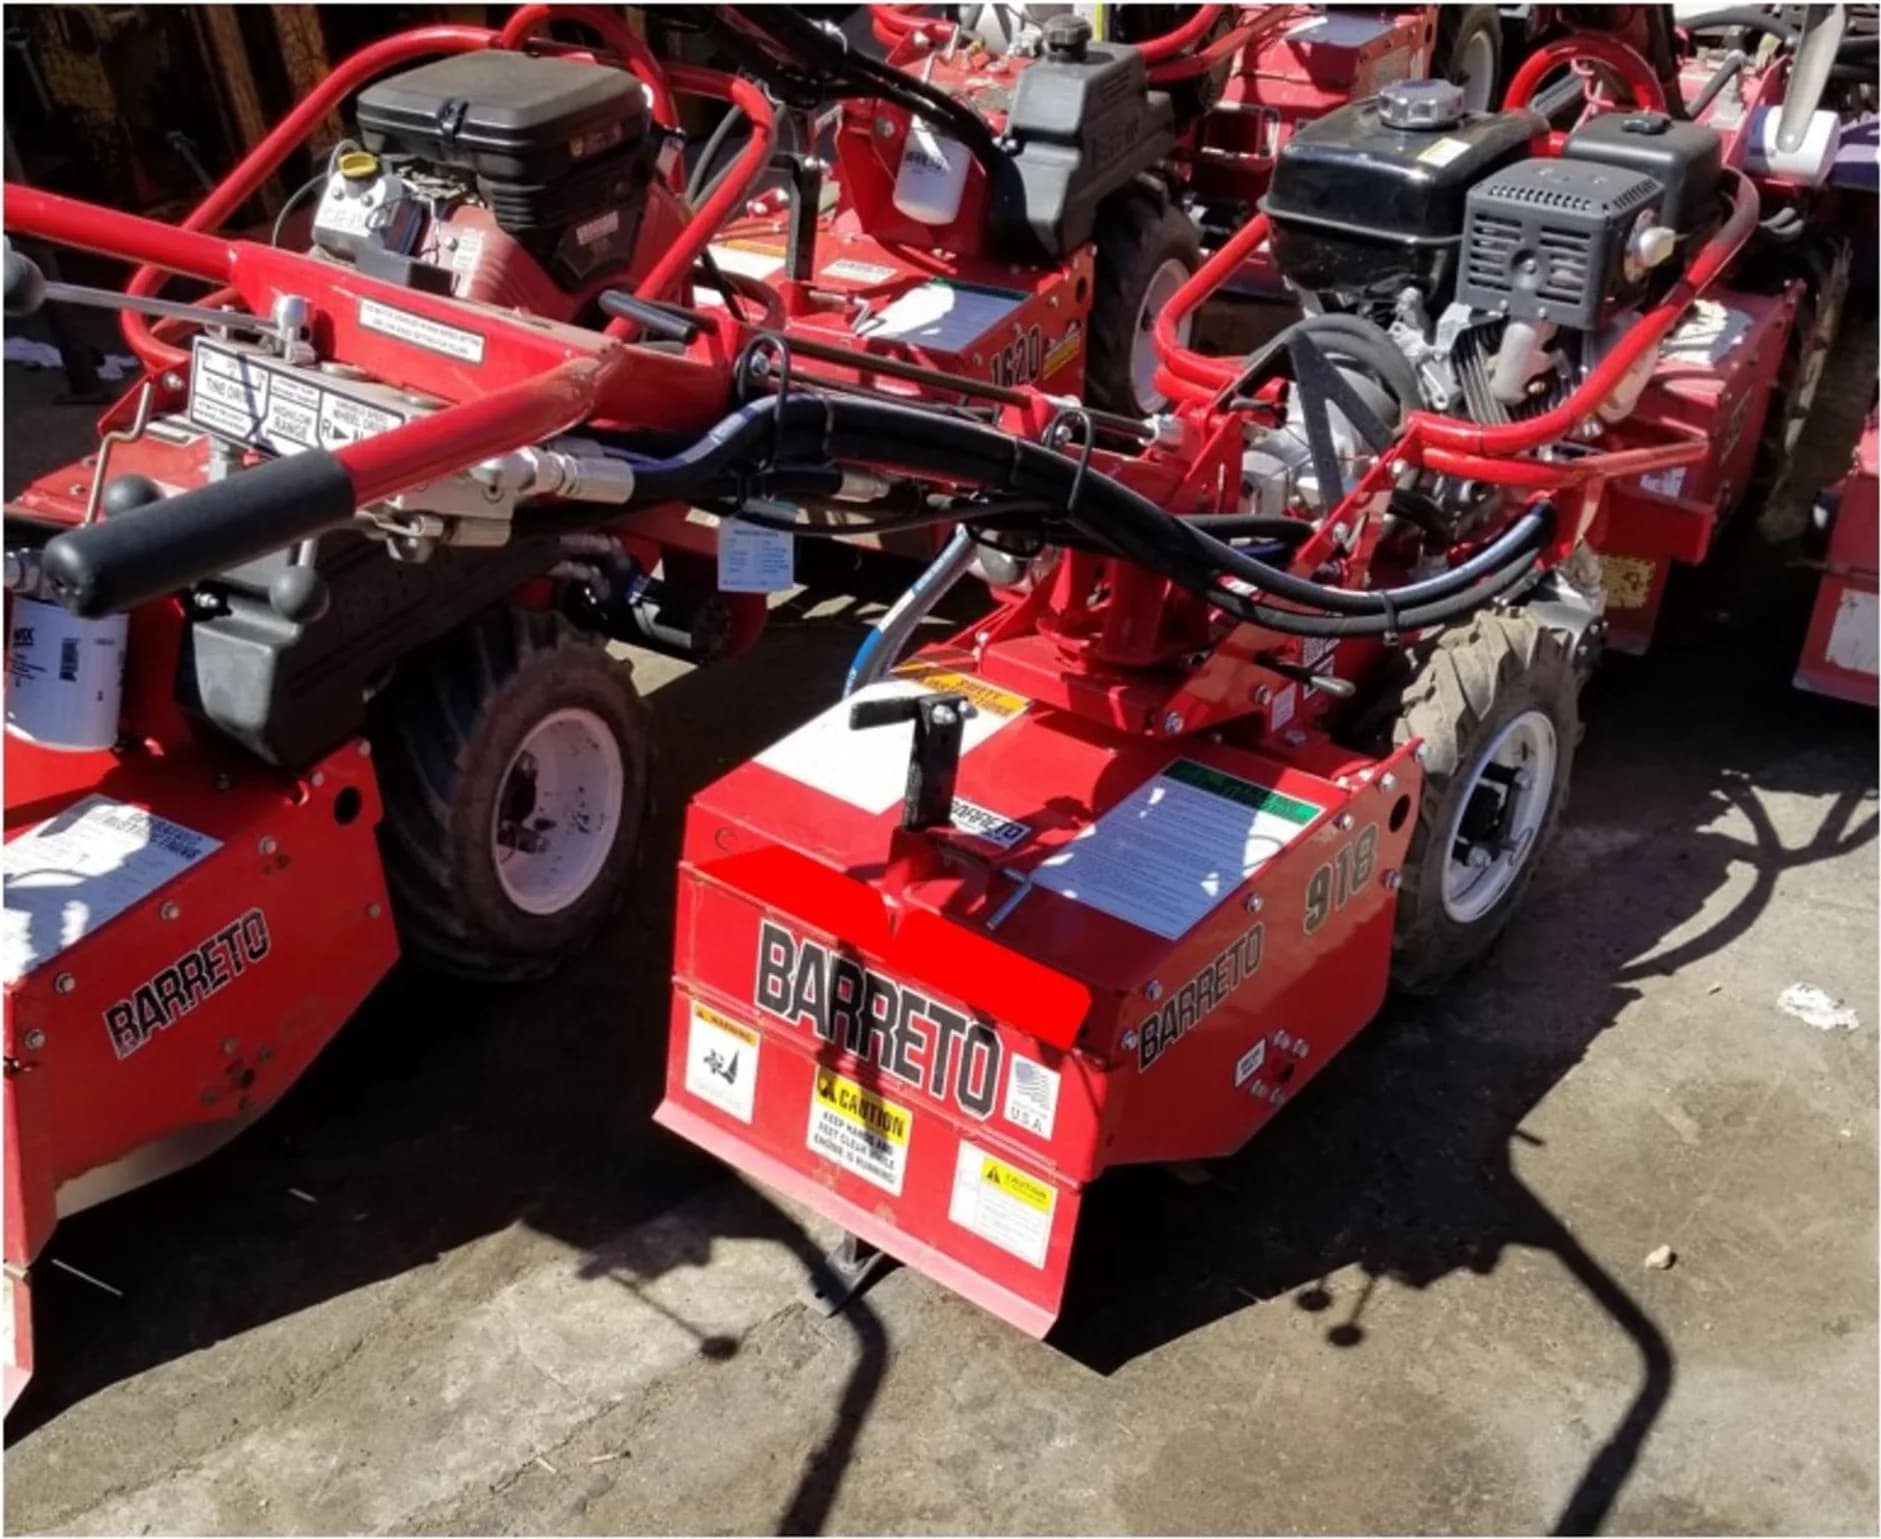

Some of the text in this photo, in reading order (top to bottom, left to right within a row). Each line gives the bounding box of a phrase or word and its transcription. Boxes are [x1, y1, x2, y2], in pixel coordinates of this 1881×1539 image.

[321, 418, 332, 435] R
[1303, 821, 1379, 936] 918
[103, 907, 271, 1061] BARRETO
[754, 918, 1003, 1121] BARRETO
[1138, 921, 1264, 1074] BARRETO
[823, 1111, 846, 1131] KEEP
[839, 1088, 906, 1139] CAUTION
[839, 1130, 868, 1156] CLEAR
